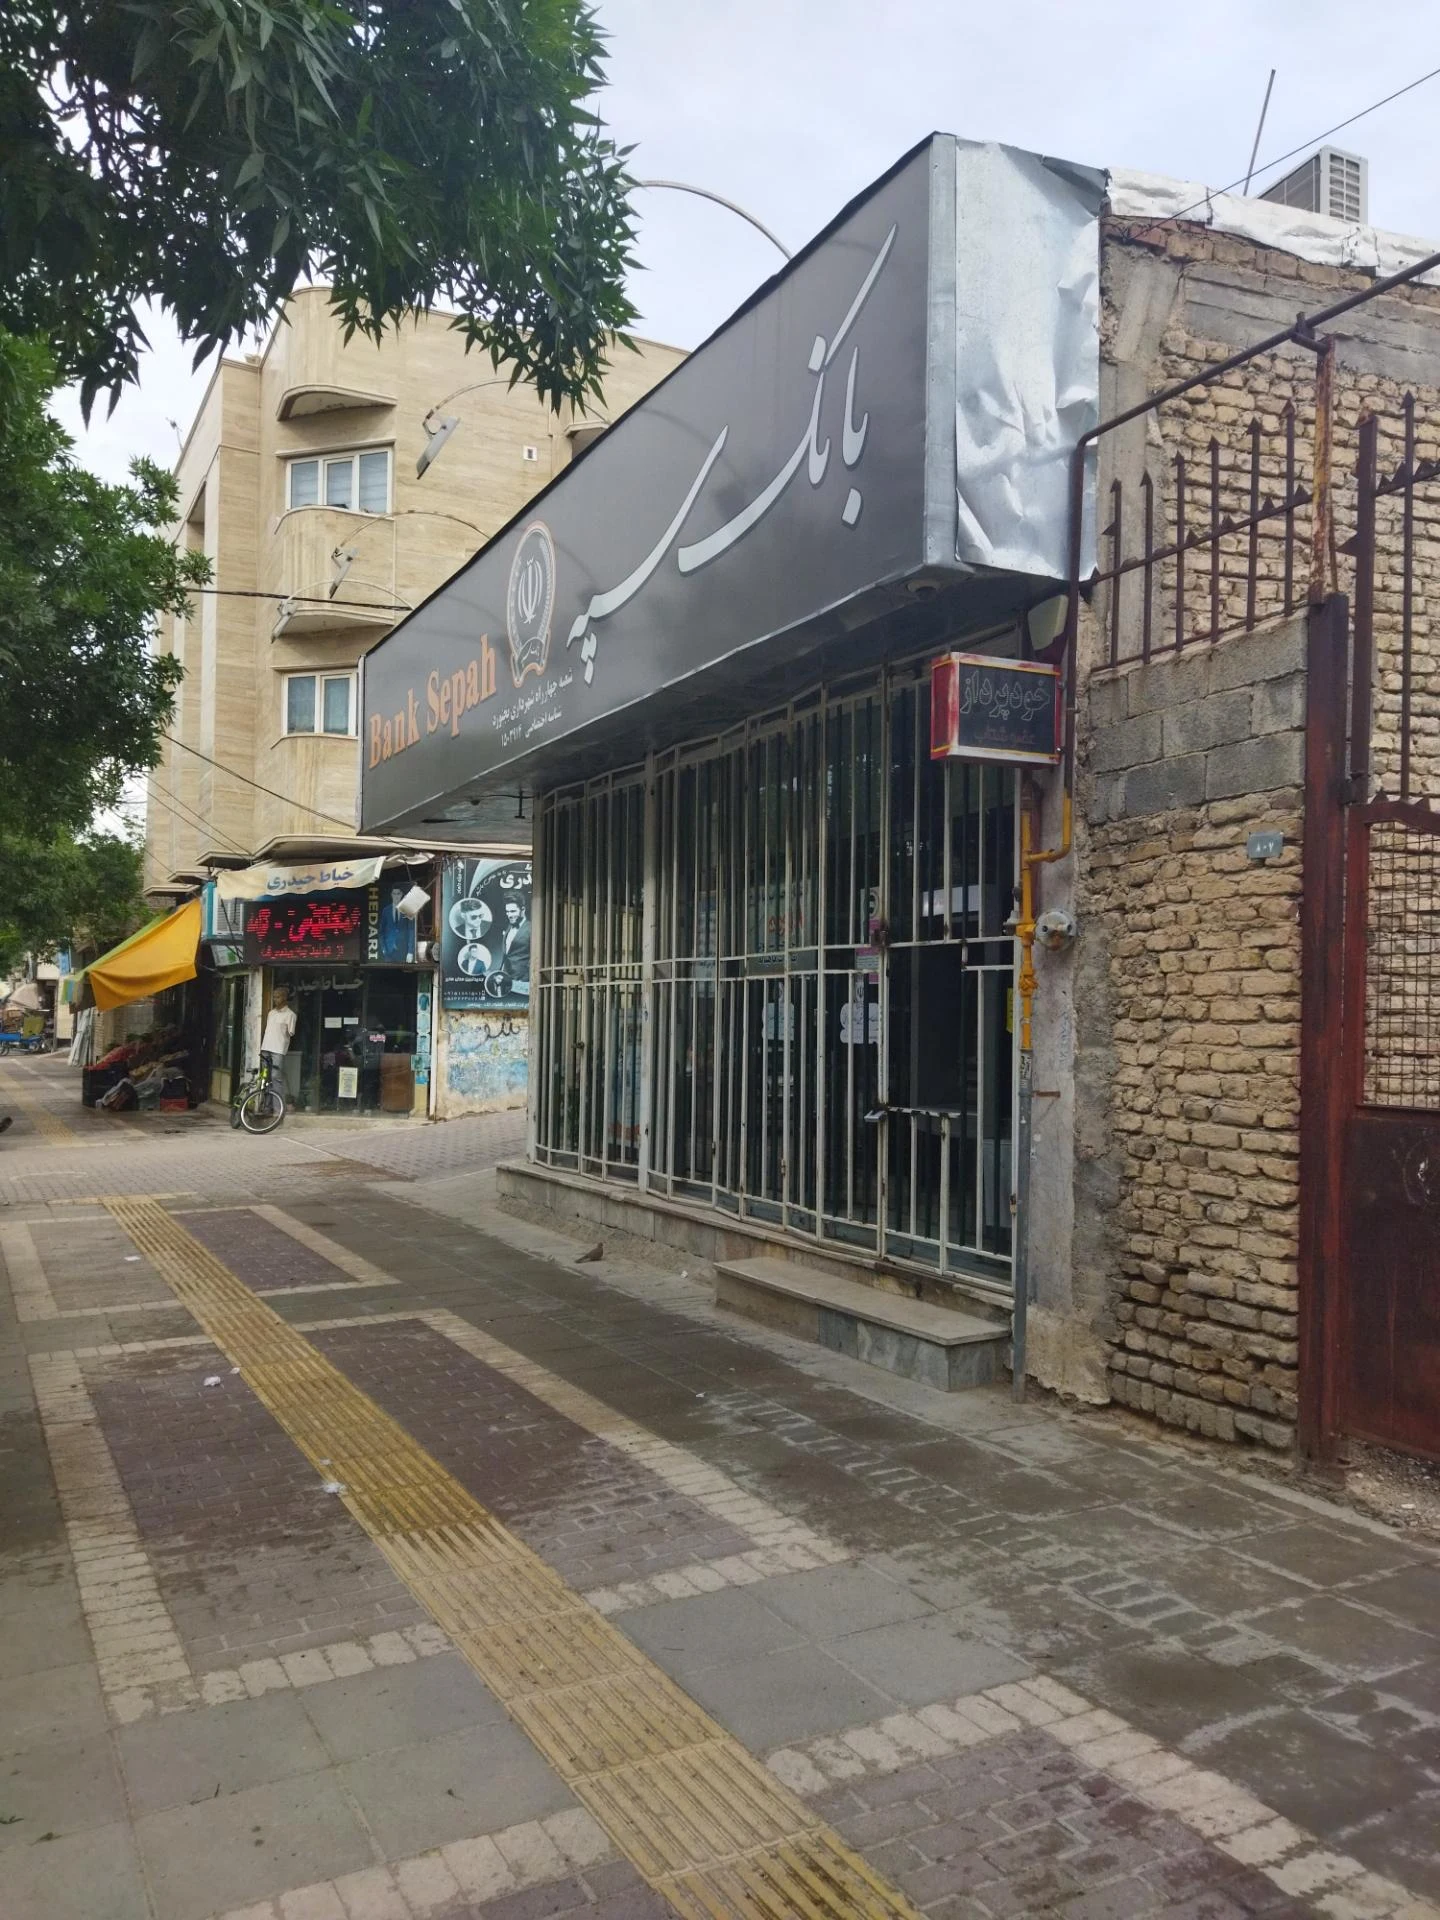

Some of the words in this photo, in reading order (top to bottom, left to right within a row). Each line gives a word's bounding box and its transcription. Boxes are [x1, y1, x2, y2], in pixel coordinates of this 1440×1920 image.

[678, 223, 899, 576] بانک
[566, 422, 729, 686] سپه
[368, 688, 421, 770] Bank
[427, 632, 497, 738] Sepah
[960, 669, 1051, 722] خودپرداز
[266, 875, 316, 891] حیدری
[320, 866, 354, 885] خیاط
